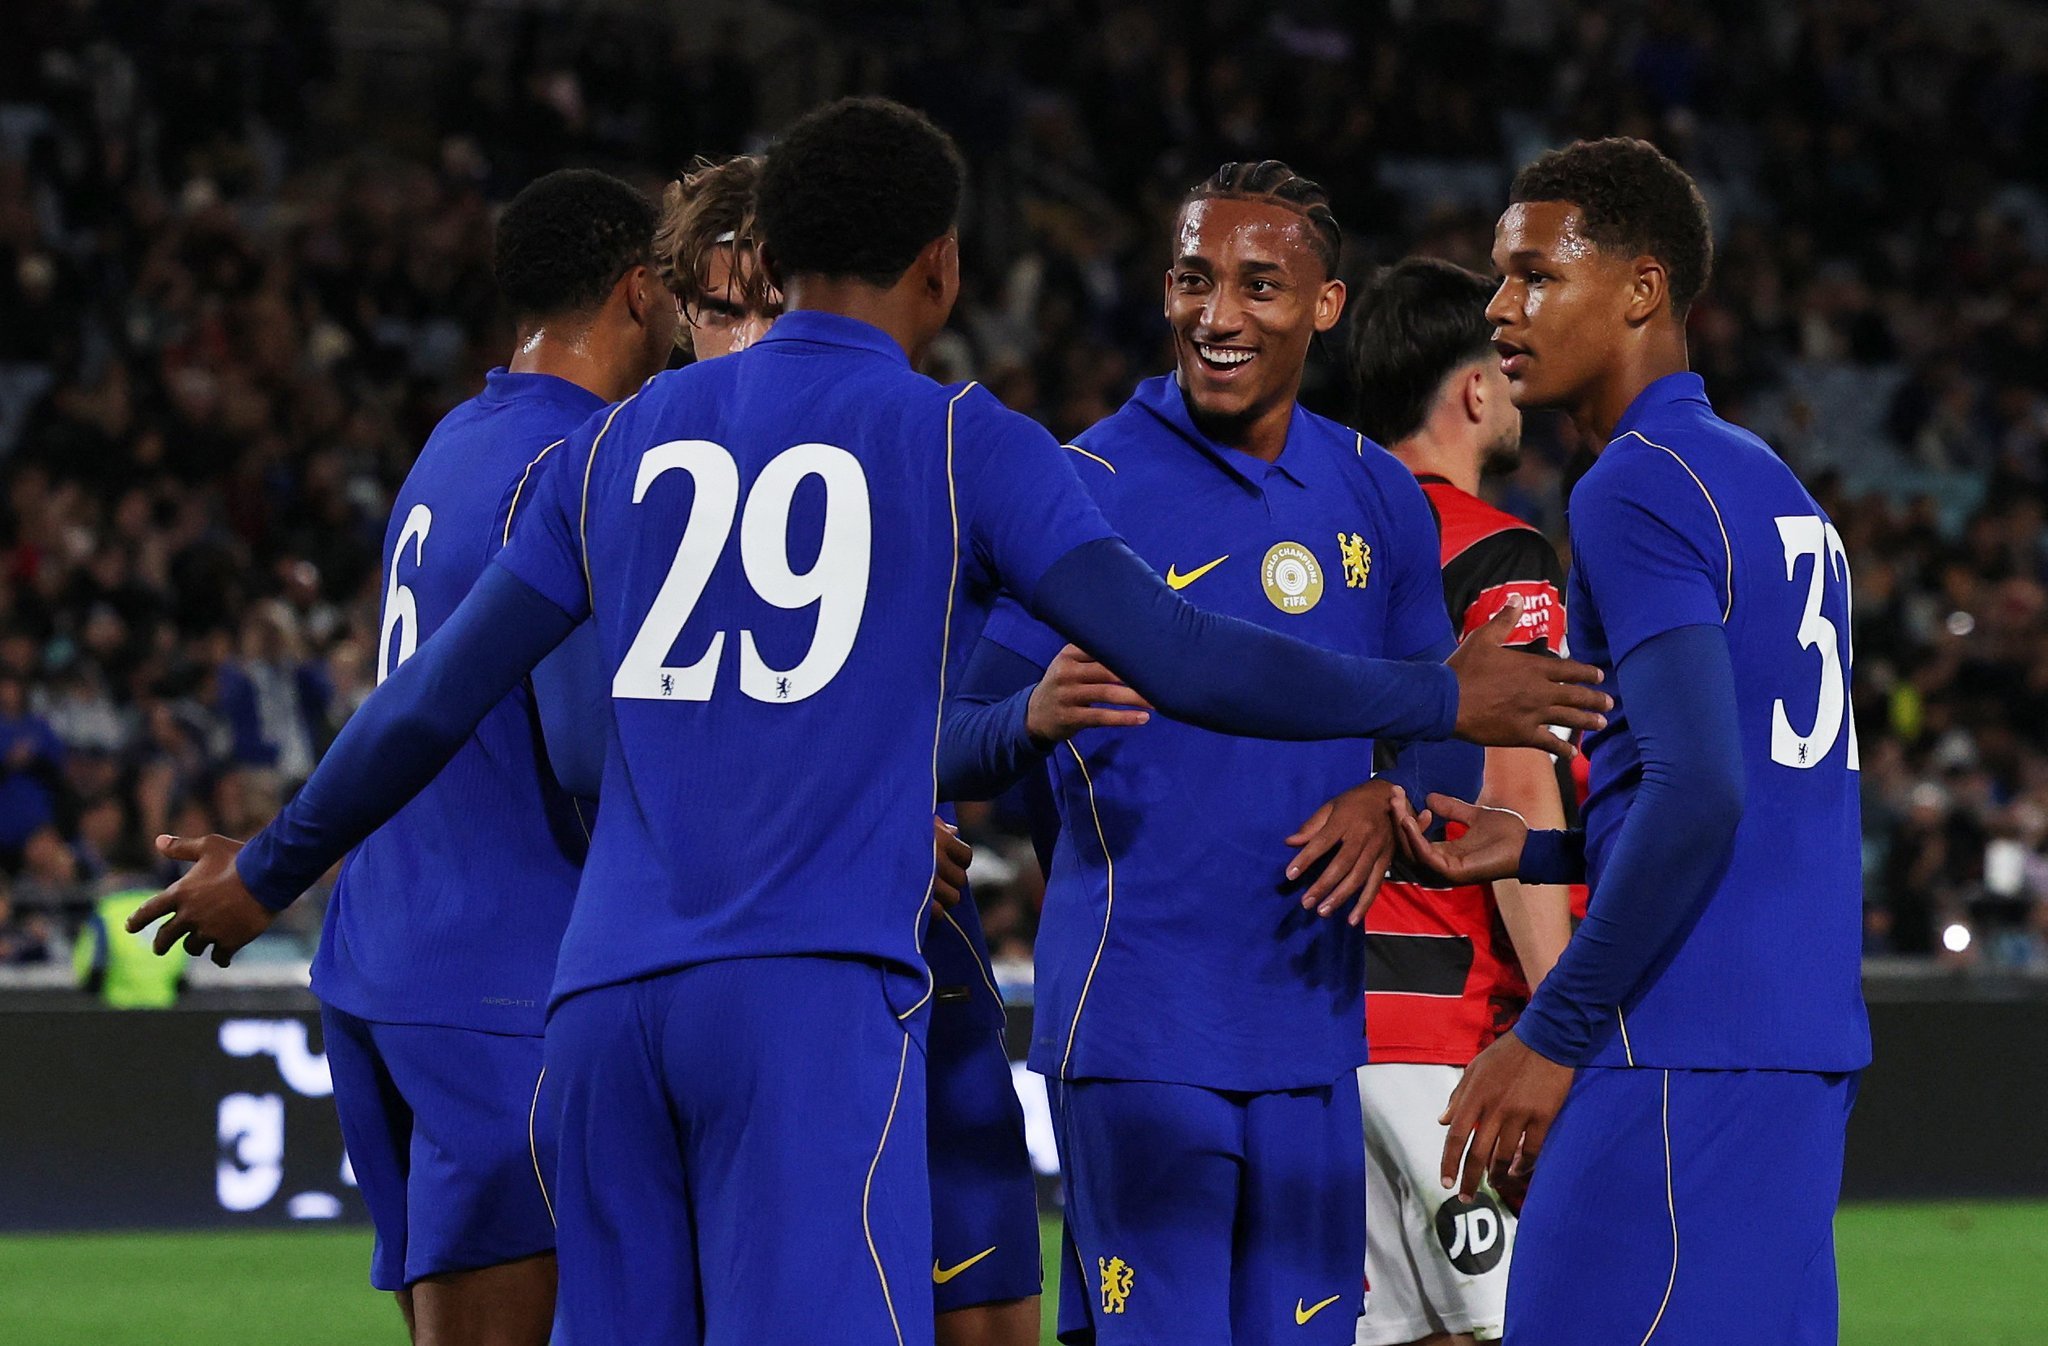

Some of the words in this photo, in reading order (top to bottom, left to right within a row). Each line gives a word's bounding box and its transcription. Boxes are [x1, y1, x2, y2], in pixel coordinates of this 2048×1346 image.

[611, 439, 872, 704] 29
[1266, 554, 1279, 587] WORLD
[1278, 547, 1318, 584] CHAMPIONS
[377, 504, 432, 688] 6
[1283, 596, 1308, 607] FIFA
[1506, 592, 1553, 610] urn
[1449, 1207, 1498, 1260] JD
